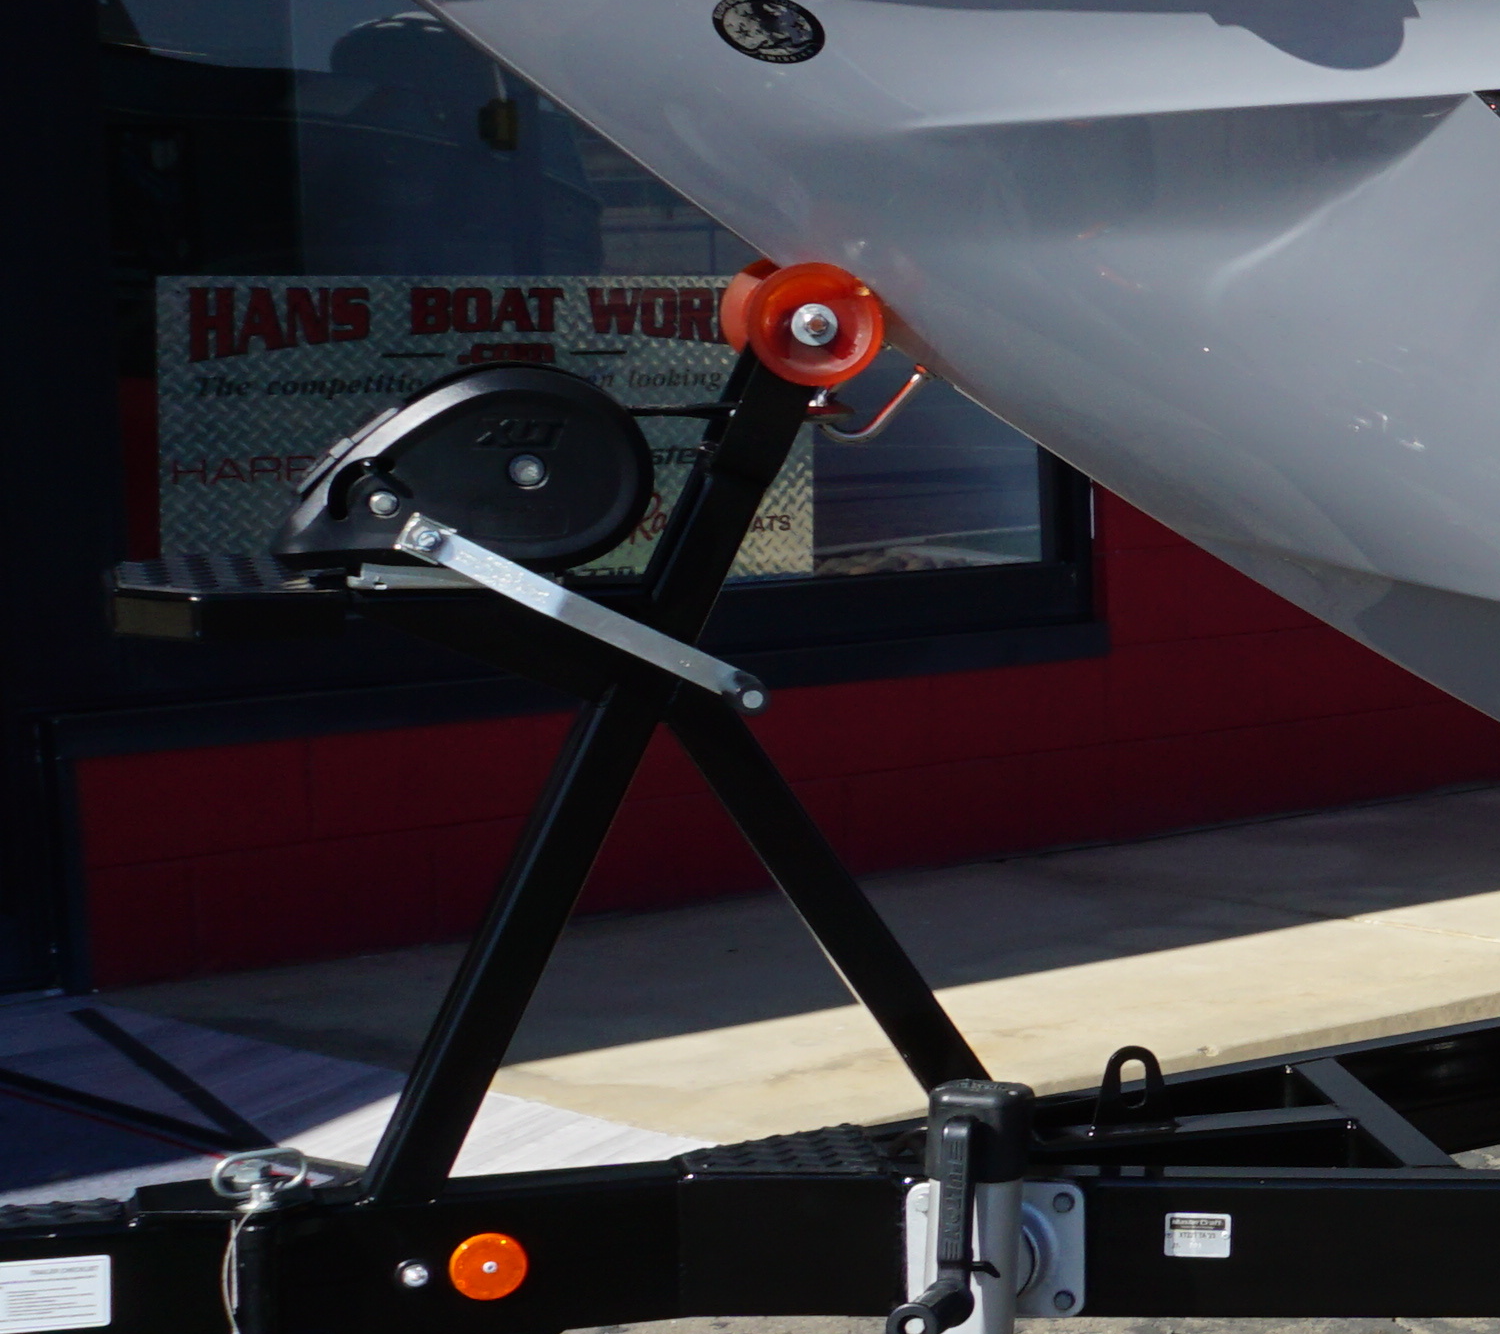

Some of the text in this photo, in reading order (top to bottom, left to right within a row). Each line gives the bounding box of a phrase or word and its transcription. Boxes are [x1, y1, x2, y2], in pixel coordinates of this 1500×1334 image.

[189, 287, 370, 363] HANS
[409, 287, 564, 335] BOAT
[197, 375, 251, 397] The
[267, 373, 426, 401] competitio
[627, 368, 722, 391] looking
